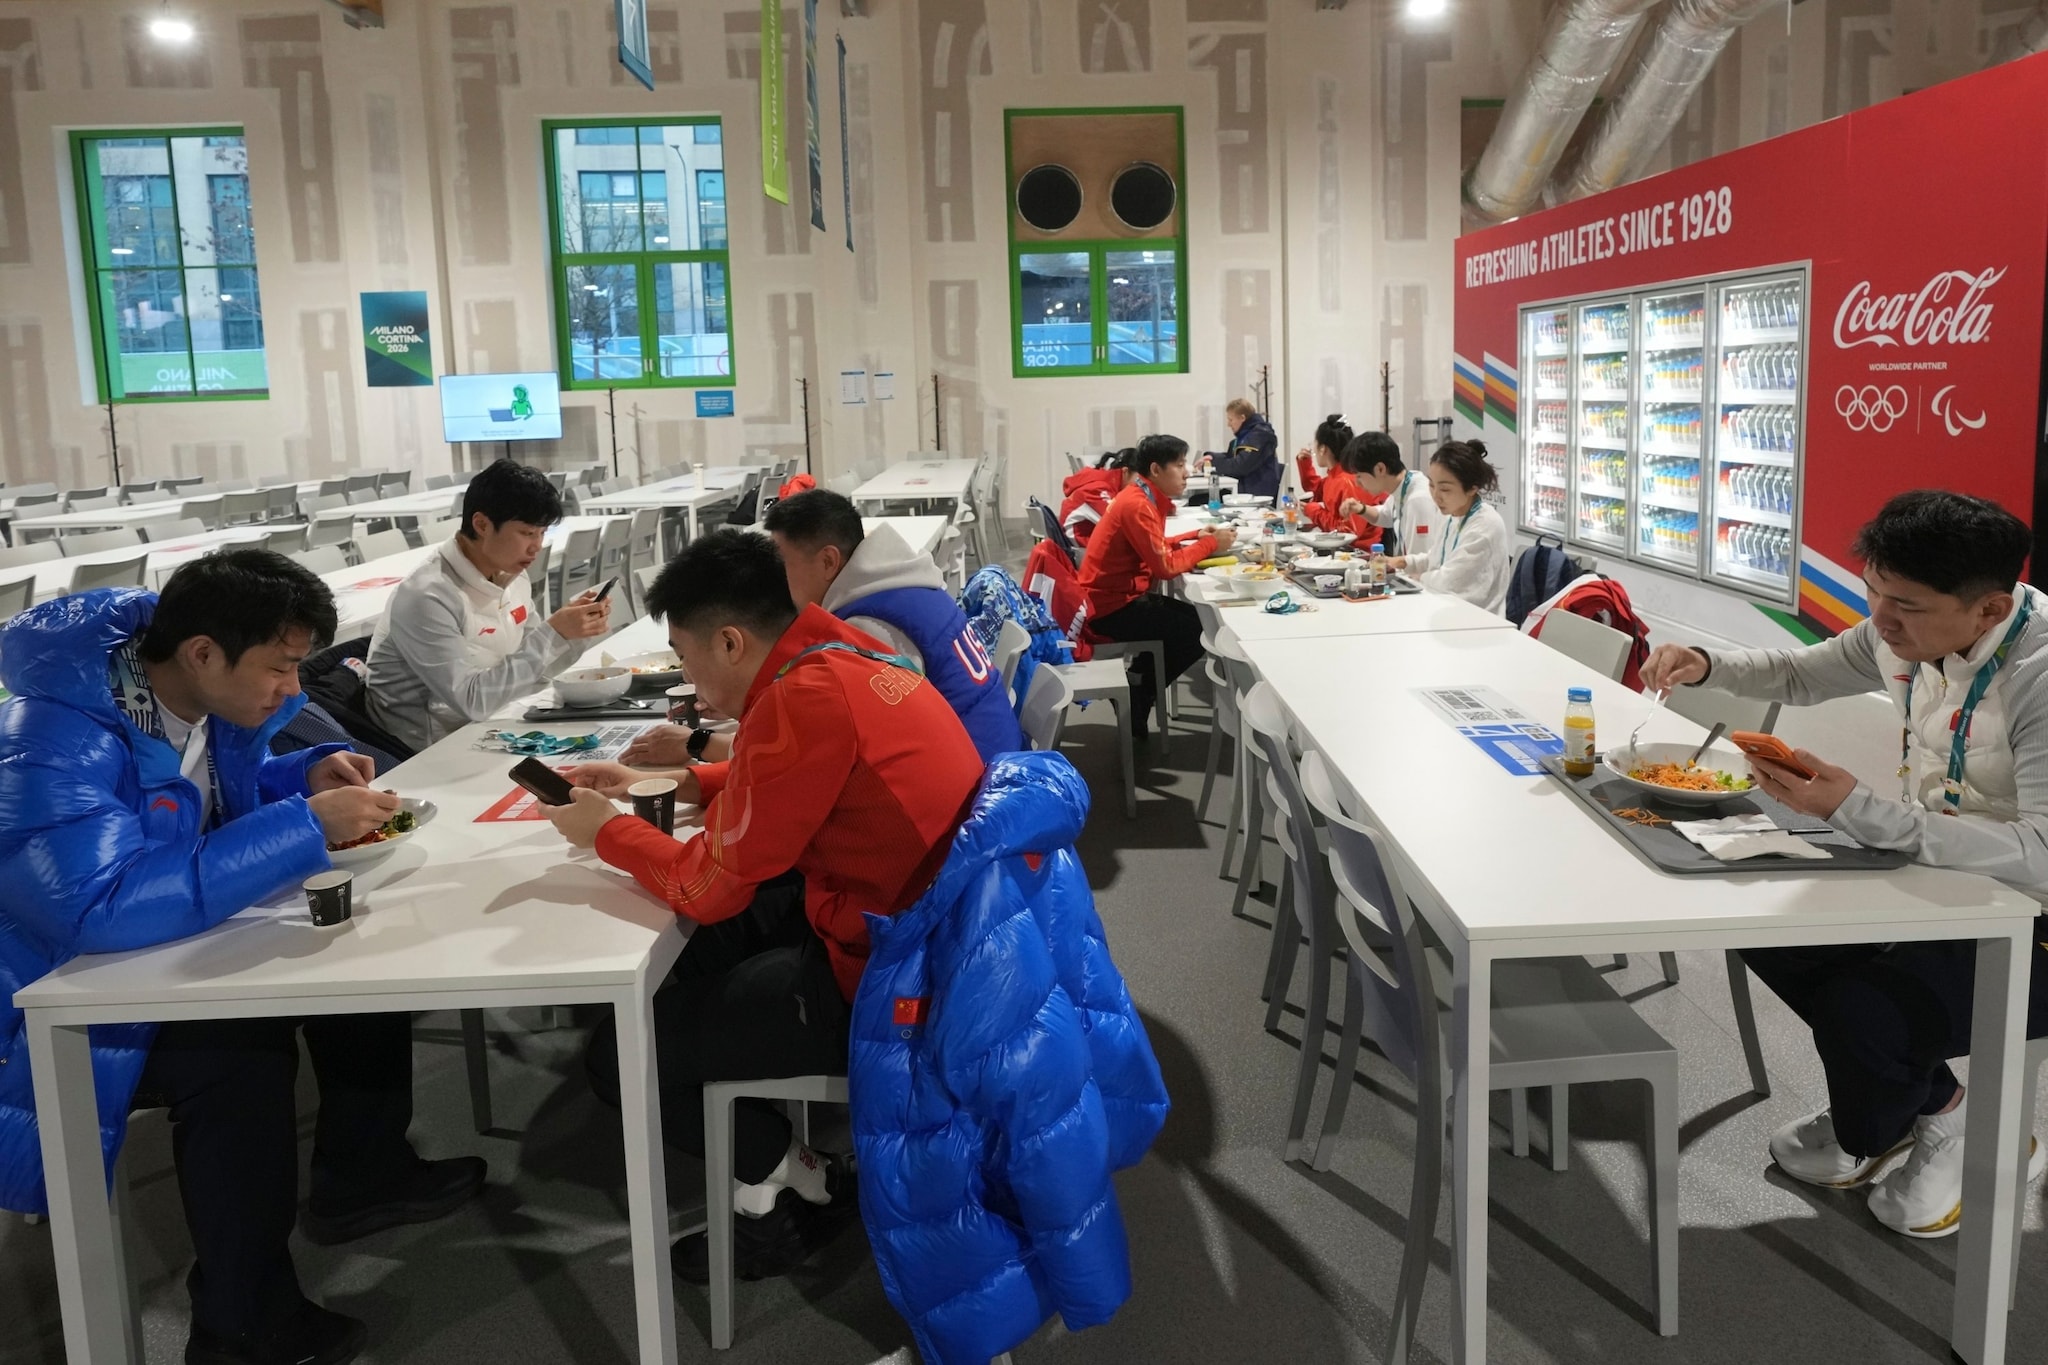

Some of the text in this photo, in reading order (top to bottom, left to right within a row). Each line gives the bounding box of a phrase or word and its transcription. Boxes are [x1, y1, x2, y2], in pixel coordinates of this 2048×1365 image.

[1466, 186, 1732, 288] REFRESHING ATHLETES SINCE 1928
[1833, 265, 2008, 349] Coca-Cola
[370, 325, 415, 335] MILANO
[378, 334, 424, 344] CORTINA
[387, 344, 409, 353] 2026
[1869, 361, 1948, 371] WORLDWIDE PARTNER
